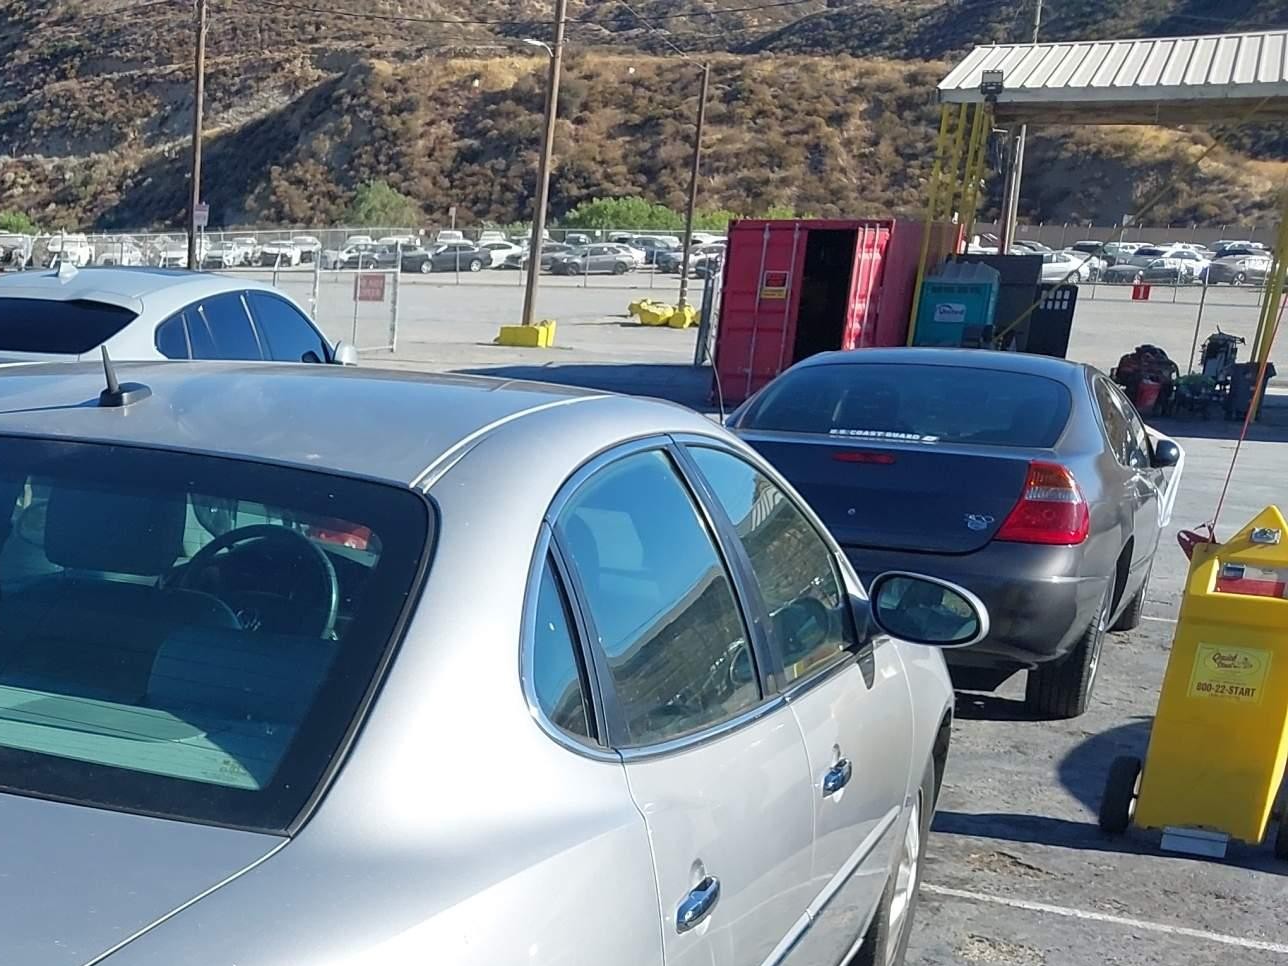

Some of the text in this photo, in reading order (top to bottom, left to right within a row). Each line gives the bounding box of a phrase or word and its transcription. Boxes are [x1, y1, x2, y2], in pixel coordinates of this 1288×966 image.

[850, 429, 884, 437] COAST
[885, 431, 921, 440] GUARD
[1196, 681, 1257, 697] 800-22-START
